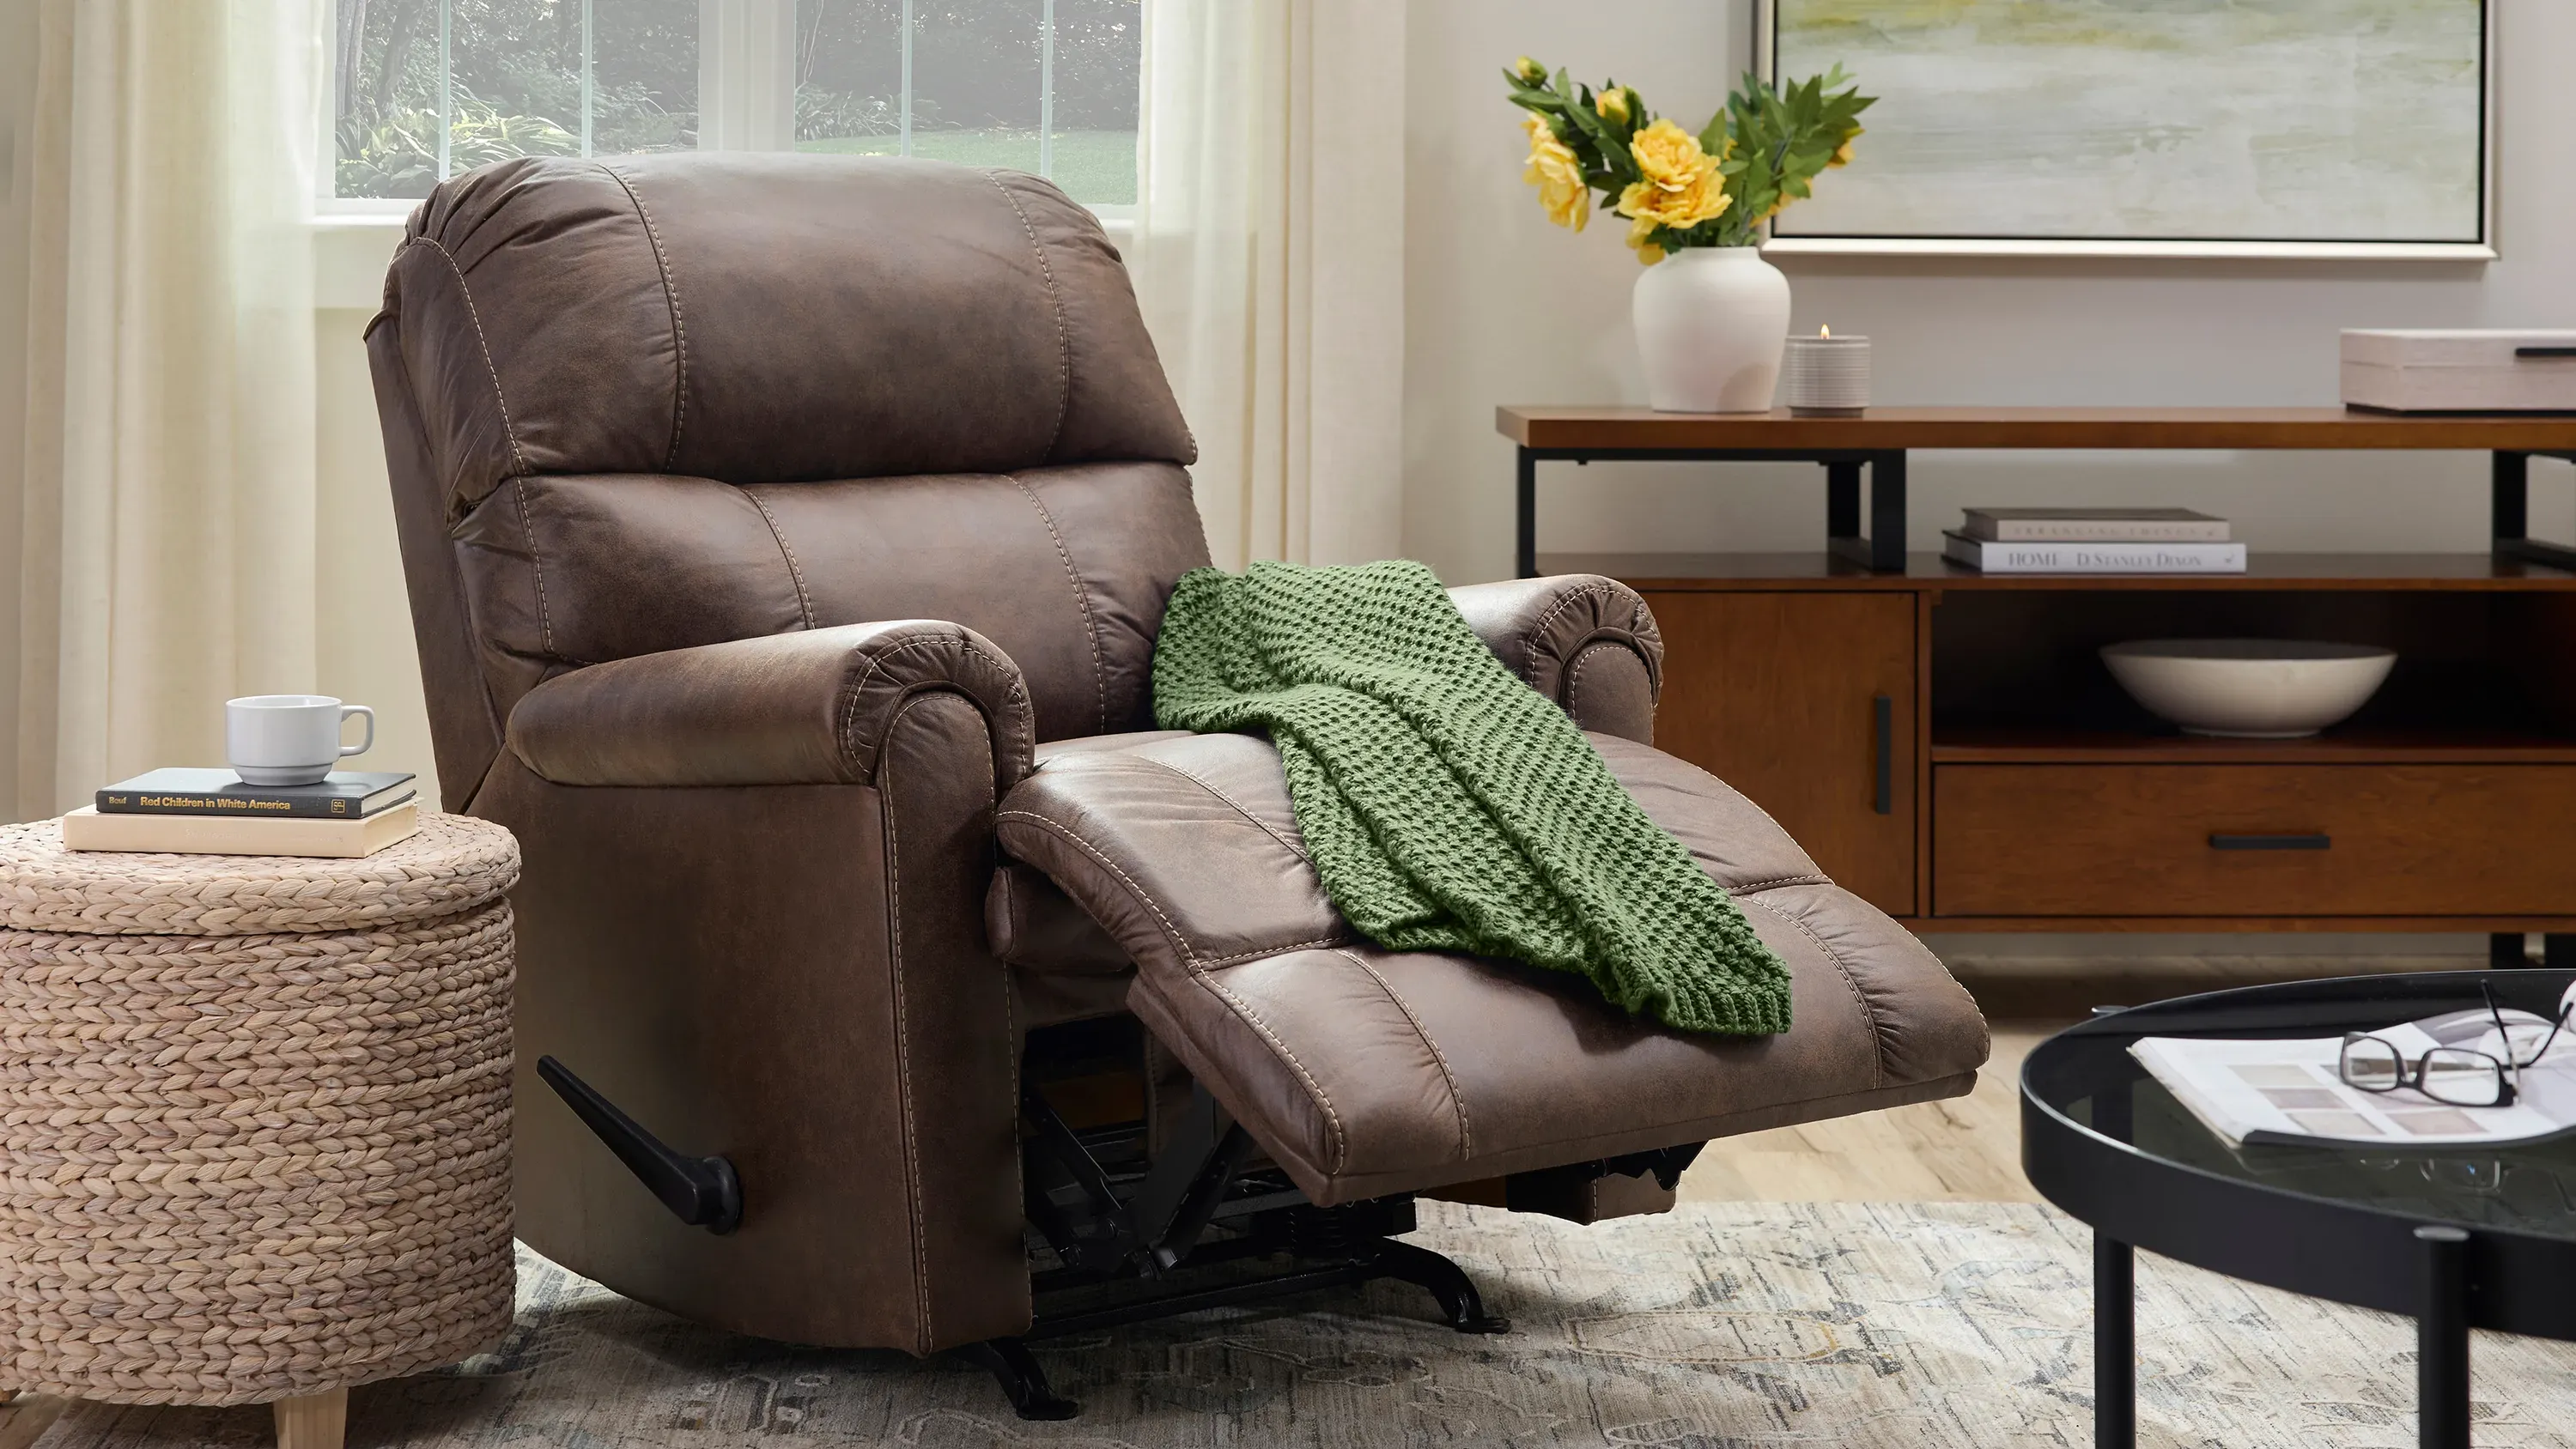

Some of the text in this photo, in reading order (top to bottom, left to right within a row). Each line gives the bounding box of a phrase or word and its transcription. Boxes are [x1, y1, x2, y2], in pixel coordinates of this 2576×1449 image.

[140, 797, 291, 810] Red Children in White America
